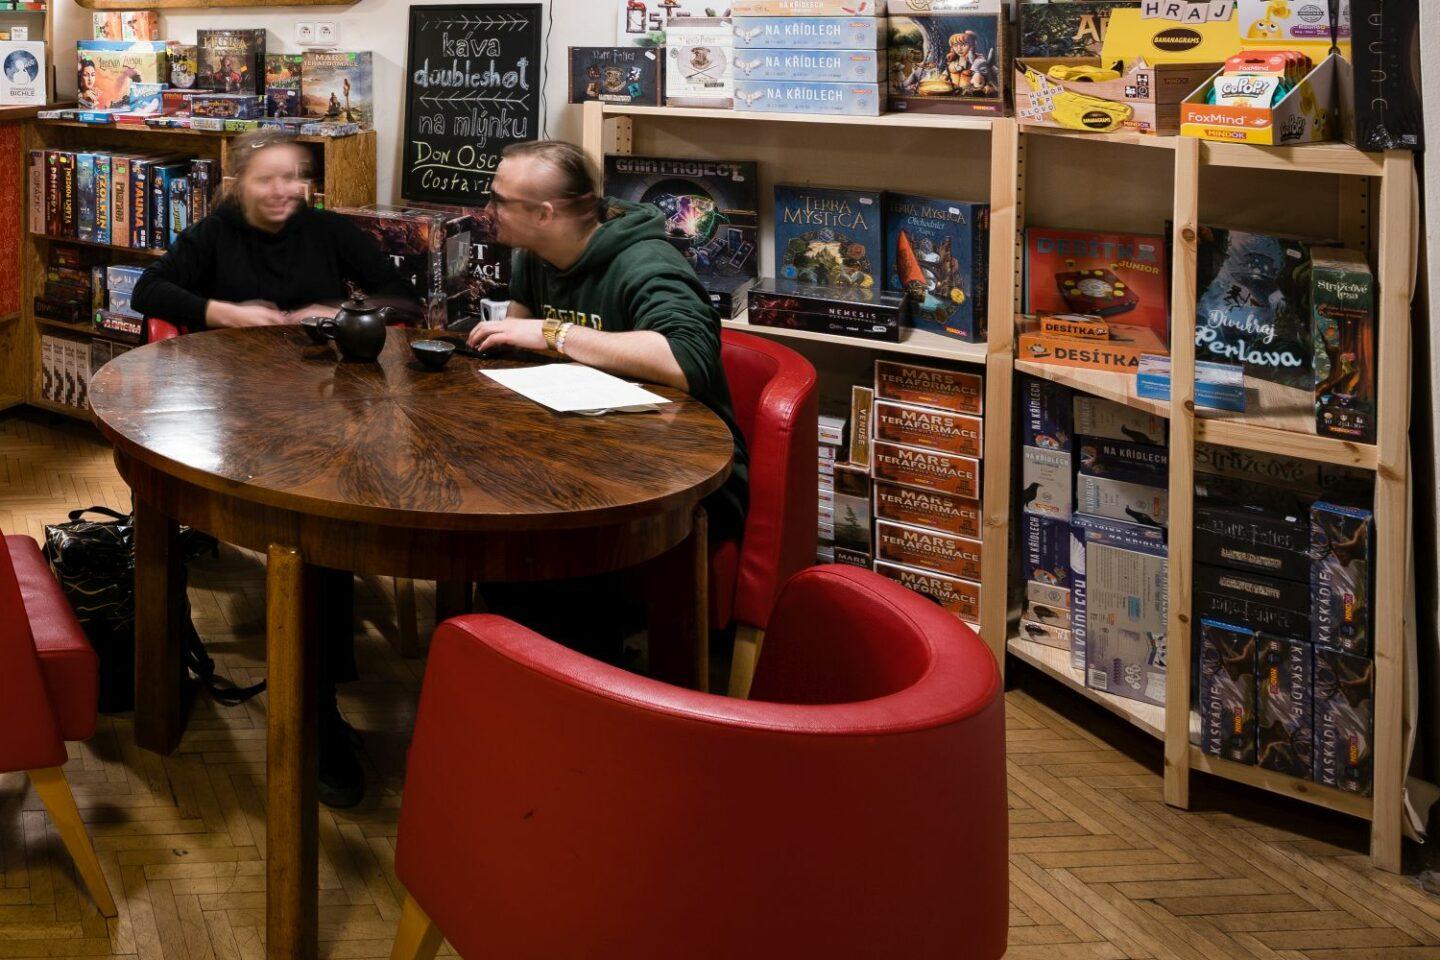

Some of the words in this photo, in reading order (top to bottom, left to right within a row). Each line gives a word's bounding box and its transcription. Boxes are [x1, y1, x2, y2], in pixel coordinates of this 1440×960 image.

[765, 24, 780, 36] NA
[785, 22, 841, 36] KŘÍDLECH
[442, 31, 501, 58] káva
[765, 56, 780, 68] NA
[785, 54, 841, 69] KŘÍDLECH
[413, 56, 530, 90] doubleshot
[767, 88, 783, 100] NA
[786, 86, 843, 101] KŘÍDLECH
[419, 114, 446, 135] na
[453, 107, 527, 148] mlýnku
[1188, 112, 1246, 125] FoxMind
[135, 180, 144, 228] FAUNA
[801, 195, 852, 213] TERRA
[783, 207, 868, 230] MYSTICA
[1119, 260, 1160, 275] JUNIOR
[828, 308, 876, 319] NEMESIS
[1045, 321, 1095, 336] DESÍTKA
[1195, 326, 1302, 367] Perlava
[1054, 347, 1140, 367] DESÍTKA
[880, 373, 977, 395] TERAFORMACE
[902, 368, 954, 384] MARS
[880, 415, 978, 439] TERAFORMACE
[901, 410, 954, 427] MARS
[898, 449, 950, 467] MARS
[1103, 445, 1116, 456] NA
[1119, 448, 1168, 465] KŘÍDLECH
[877, 454, 973, 480] TERAFORMACE
[879, 493, 977, 519] TERAFORMACE
[901, 489, 954, 508] MARS
[882, 535, 979, 561] TERAFORMACE
[903, 531, 956, 549] MARS
[838, 553, 866, 565] MARS
[901, 571, 953, 592] MARS
[1318, 571, 1333, 648] KASKÁDIE
[1289, 644, 1303, 717] KASKÁDIE
[1210, 686, 1223, 755] KASKÁDIE
[1322, 713, 1336, 786] KASKÁDIE
